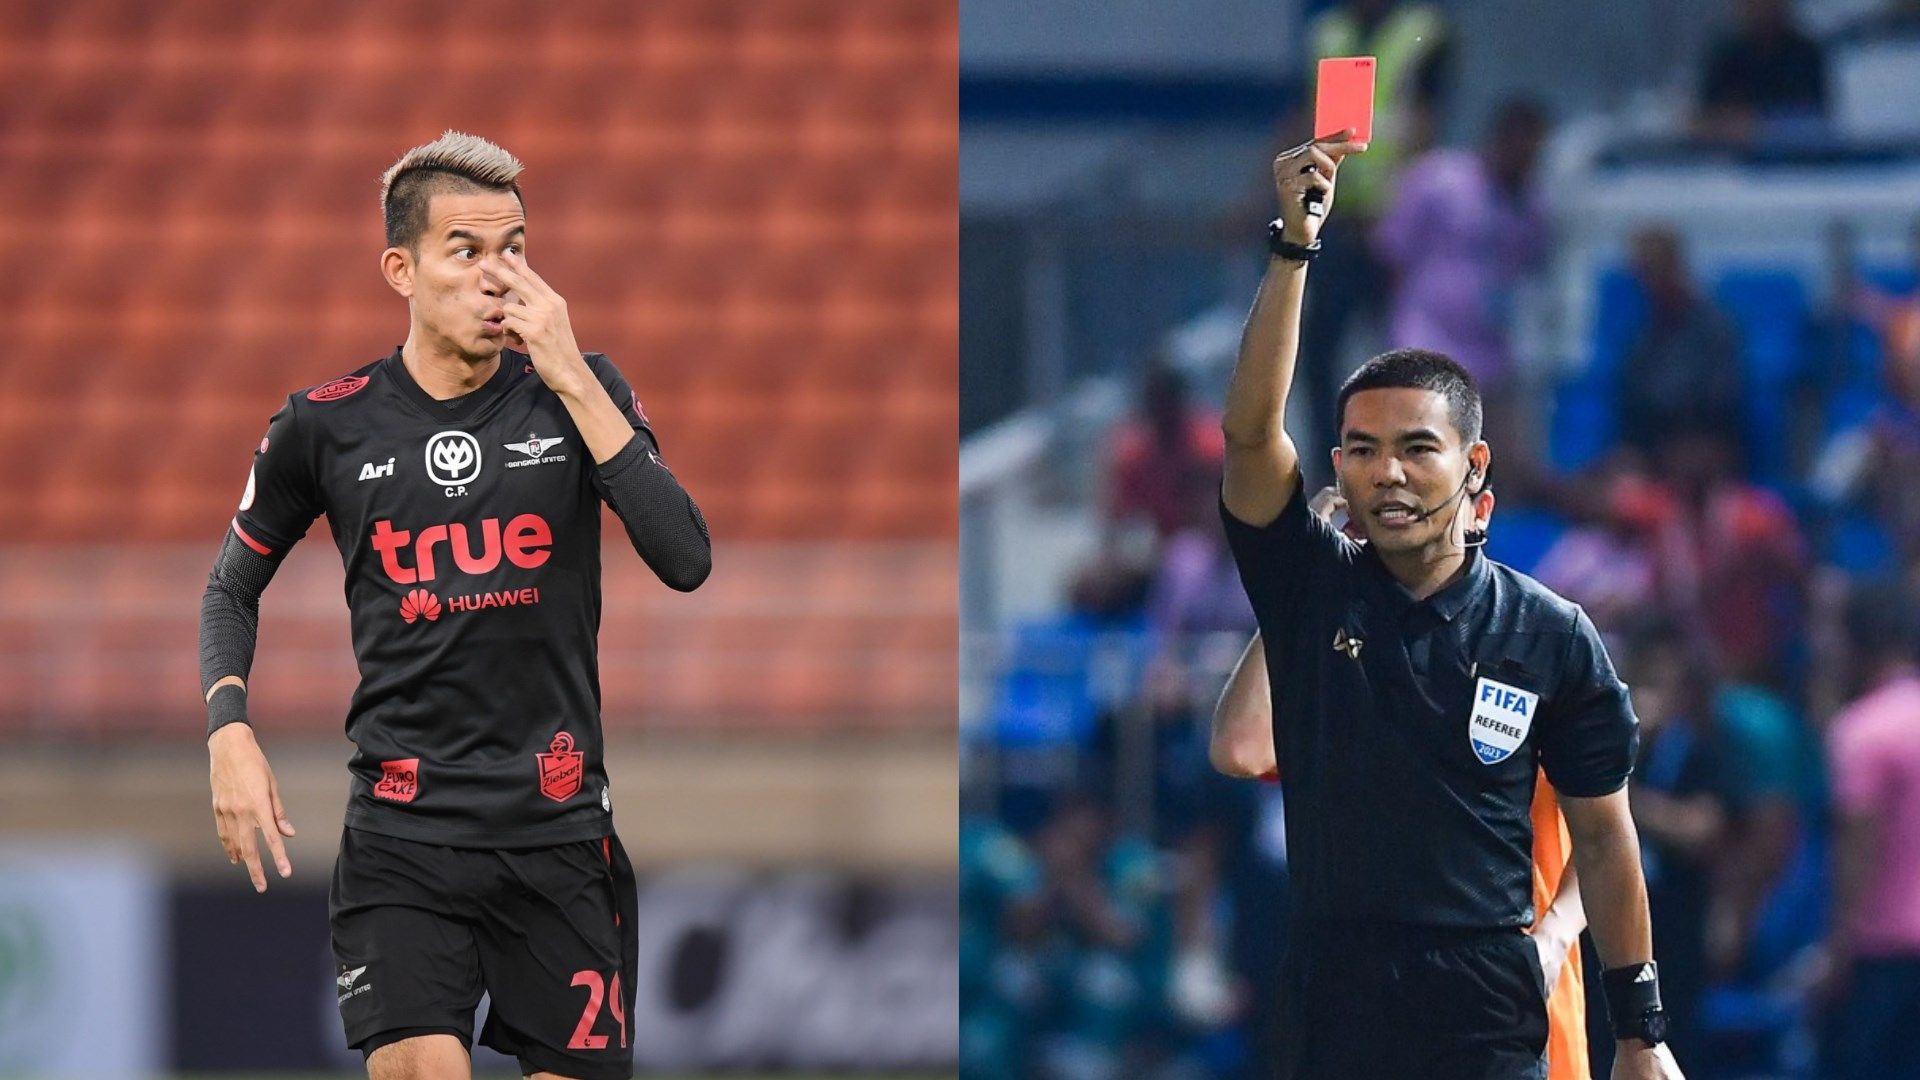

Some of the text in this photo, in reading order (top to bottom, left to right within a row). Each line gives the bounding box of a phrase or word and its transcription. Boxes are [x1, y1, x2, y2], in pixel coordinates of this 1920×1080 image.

[358, 457, 396, 481] Ari
[508, 459, 541, 468] BANGKOK
[541, 455, 566, 463] UNITED
[445, 486, 468, 497] C.P.
[371, 513, 553, 585] true
[448, 588, 539, 613] HUAWEI
[1480, 684, 1528, 717] FIFA
[1475, 714, 1523, 739] REFEREE
[378, 783, 415, 795] CAKE
[385, 770, 415, 784] EURO
[566, 970, 627, 1049] 29
